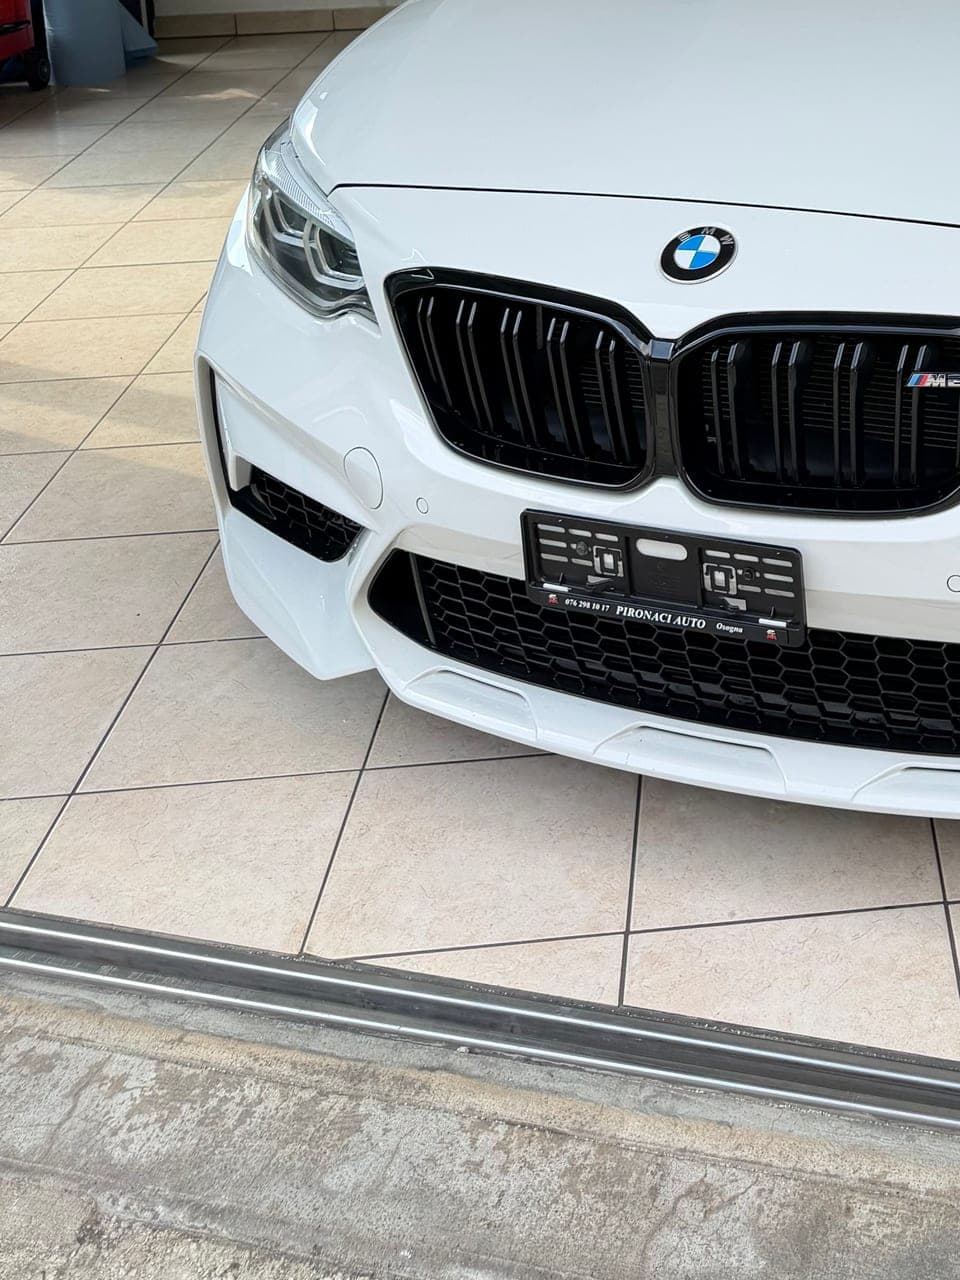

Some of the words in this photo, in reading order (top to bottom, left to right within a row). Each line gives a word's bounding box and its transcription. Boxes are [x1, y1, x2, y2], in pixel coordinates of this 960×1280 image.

[678, 226, 734, 246] BMW
[564, 597, 578, 607] 076
[578, 600, 591, 610] 298
[601, 604, 611, 613] 17
[615, 605, 673, 624] PIRONACI
[672, 615, 707, 629] AUTO
[716, 622, 744, 634] Osogna
